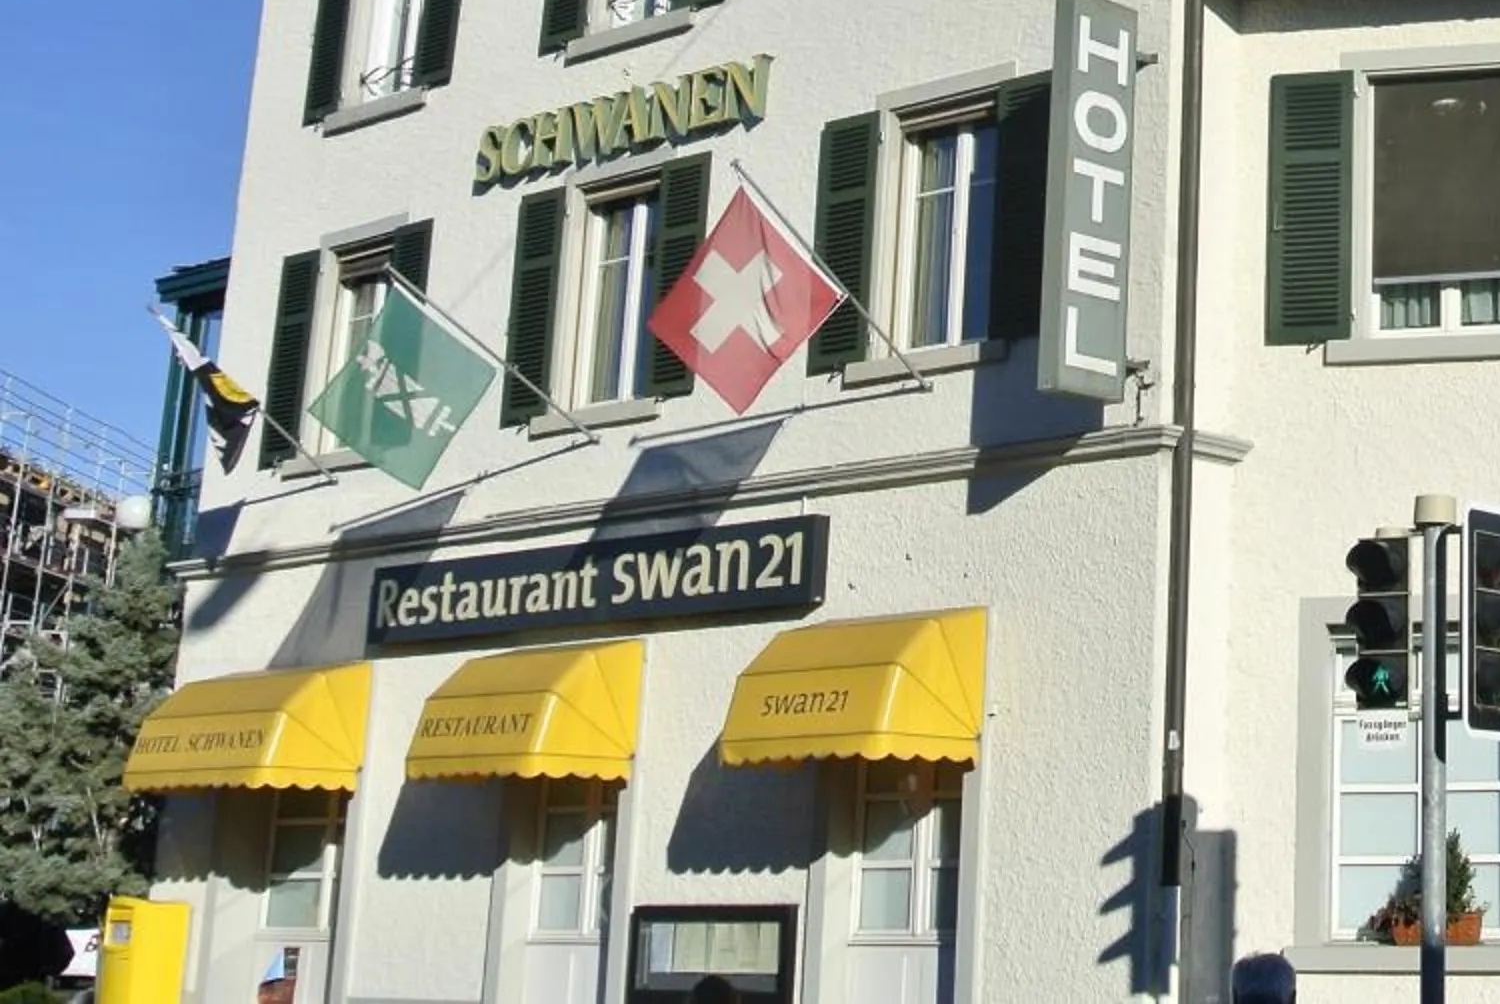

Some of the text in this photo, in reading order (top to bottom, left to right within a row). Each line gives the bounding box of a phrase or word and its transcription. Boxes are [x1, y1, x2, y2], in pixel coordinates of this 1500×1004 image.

[476, 53, 774, 182] SCHWANEN
[1064, 14, 1130, 377] HOTEL
[375, 531, 804, 629] Restaurant swan21
[421, 713, 534, 737] RESTAURANT
[761, 690, 849, 716] swan21
[135, 729, 265, 754] HOTEL SCHWANEN
